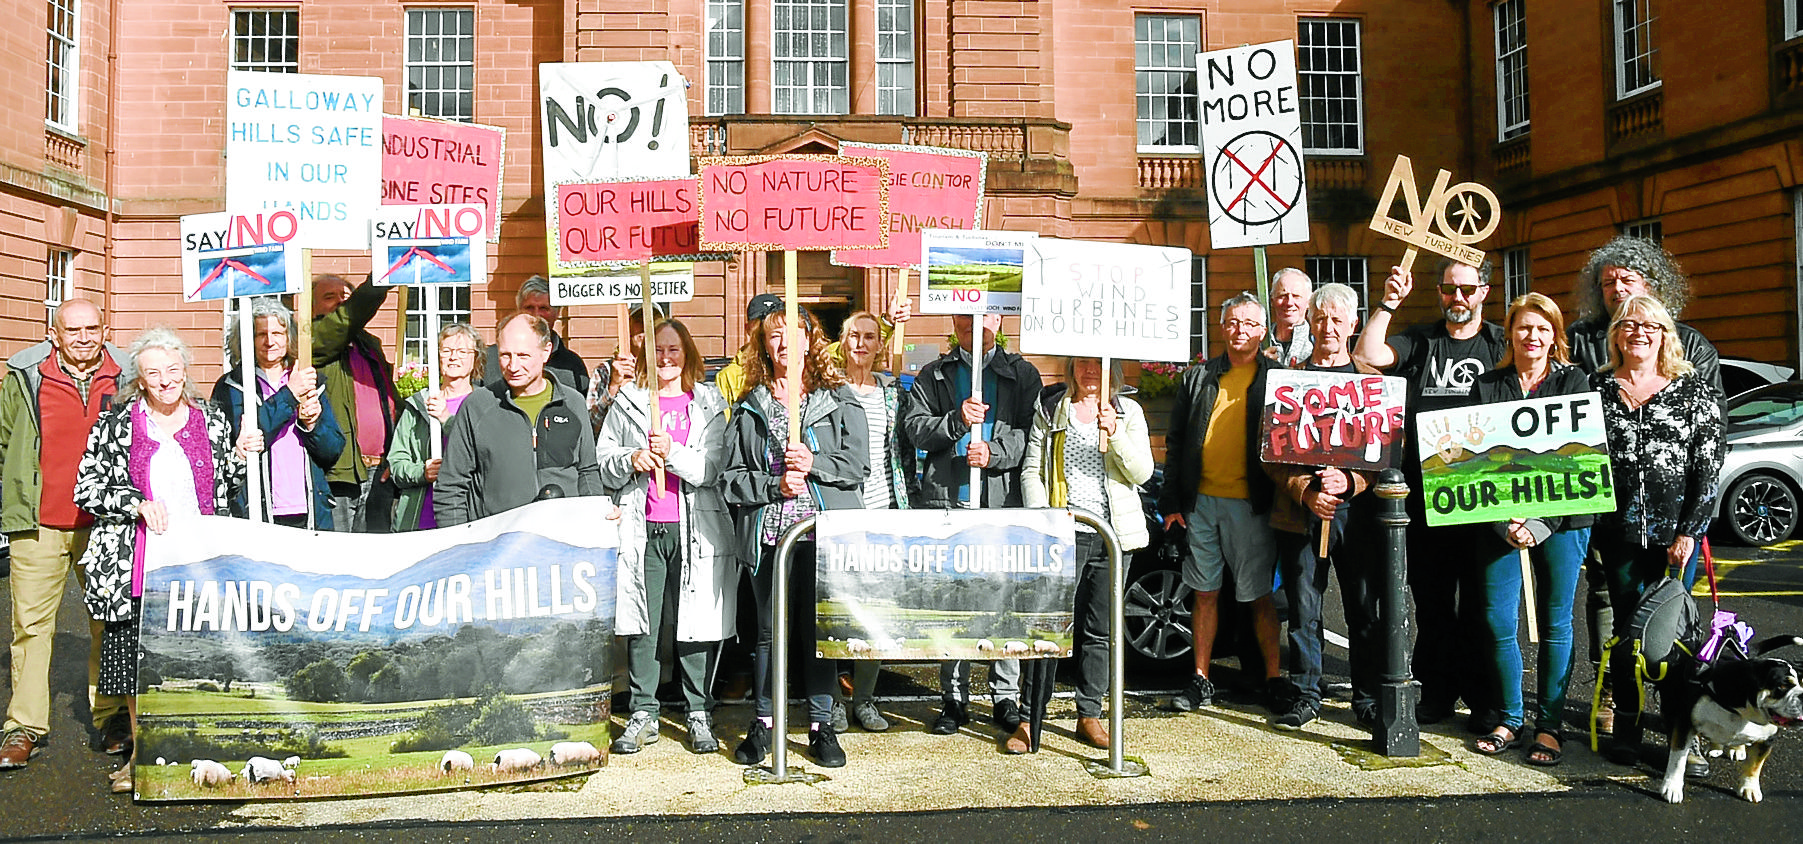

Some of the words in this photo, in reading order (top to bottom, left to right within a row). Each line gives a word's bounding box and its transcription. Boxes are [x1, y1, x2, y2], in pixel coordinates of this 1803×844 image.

[1207, 49, 1276, 90] NO
[237, 88, 374, 112] GALLOWAY
[545, 73, 668, 150] NO!
[1203, 86, 1295, 124] MORE
[232, 123, 300, 144] HILLS
[311, 126, 373, 146] SAFE
[382, 133, 487, 166] NDUSTRIAL
[268, 162, 289, 181] IN
[301, 163, 348, 183] OUR
[713, 170, 747, 195] NO
[762, 169, 858, 193] NATURE
[888, 172, 907, 187] GIE
[911, 171, 972, 189] CONTOR
[381, 179, 419, 202] BINE
[429, 183, 488, 208] SITES
[564, 189, 619, 216] OUR
[631, 189, 691, 214] HILLS
[1368, 154, 1501, 245] NO
[263, 201, 348, 221] NDS
[376, 221, 415, 238] SAY
[425, 207, 483, 238] NO
[716, 208, 749, 232] NO
[764, 206, 867, 231] FUTURE
[889, 212, 963, 233] ENWASH
[186, 230, 227, 251] SAY
[236, 211, 298, 247] NO
[566, 226, 620, 254] OUR
[629, 223, 699, 249] FUTUR
[1384, 222, 1414, 237] NEW
[1424, 235, 1482, 264] TURBINES
[1069, 263, 1144, 284] STOP
[558, 283, 605, 298] BIGGER
[610, 283, 621, 296] IS
[625, 283, 643, 296] NO
[650, 281, 689, 296] BETTER
[928, 293, 948, 302] SAY
[952, 288, 981, 302] NO
[1077, 282, 1146, 302] WIND
[1026, 297, 1179, 322] TURBINES
[1024, 314, 1044, 332] ON
[1052, 315, 1102, 336] OUR
[1115, 320, 1179, 340] HILLS
[1271, 377, 1383, 423] SOME
[1270, 406, 1403, 456] FUTURE
[1511, 399, 1590, 437] OFF
[1432, 480, 1500, 514] OUR
[1511, 464, 1612, 504] HILLS!
[830, 543, 904, 573] HANDS
[908, 543, 949, 573] OFF
[953, 543, 1000, 573] OUR
[1001, 543, 1064, 573] HILLS
[165, 580, 301, 632] HANDS
[307, 587, 389, 632] OFF
[393, 573, 474, 630] OUR
[484, 560, 598, 621] HILLS
